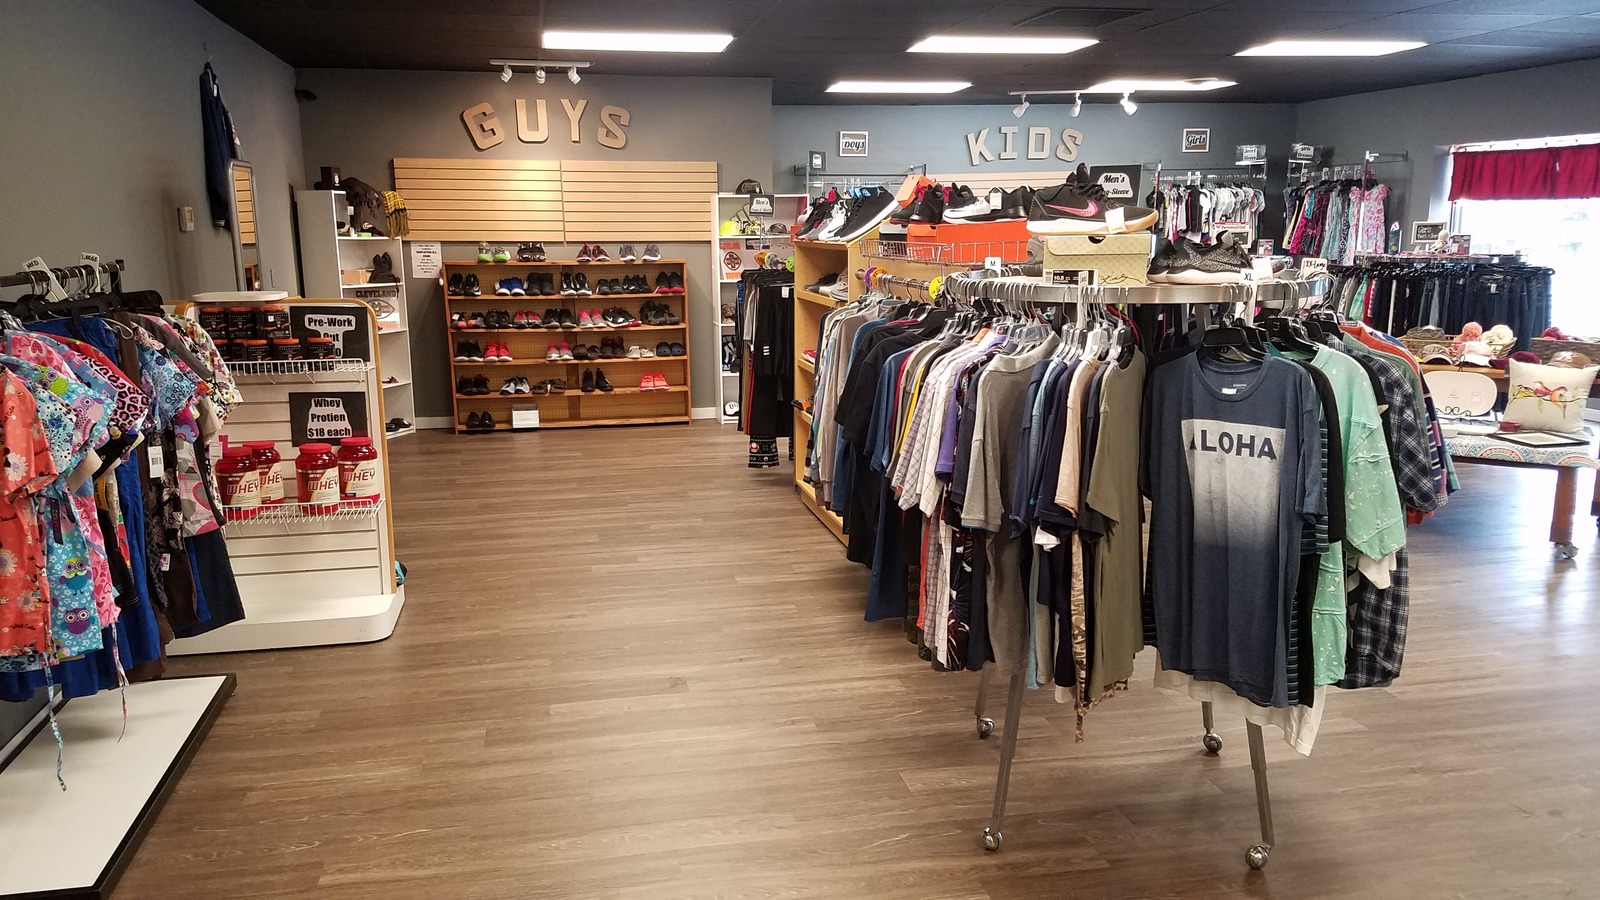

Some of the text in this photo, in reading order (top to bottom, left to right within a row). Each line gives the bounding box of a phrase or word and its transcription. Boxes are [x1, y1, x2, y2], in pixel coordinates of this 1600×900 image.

[461, 98, 631, 150] GUYS
[966, 126, 1084, 166] KIDS
[1186, 135, 1207, 147] Girls
[1103, 174, 1125, 184] Men's
[26, 260, 40, 270] MED
[1243, 273, 1254, 281] XL
[356, 290, 397, 298] CLEVELAND
[307, 317, 353, 327] Pre-Work
[313, 398, 341, 408] Whey
[310, 412, 346, 422] Protien
[308, 426, 351, 438] $18 each
[344, 470, 376, 482] WHEY
[227, 482, 260, 495] WHEY
[308, 479, 339, 491] WHEY
